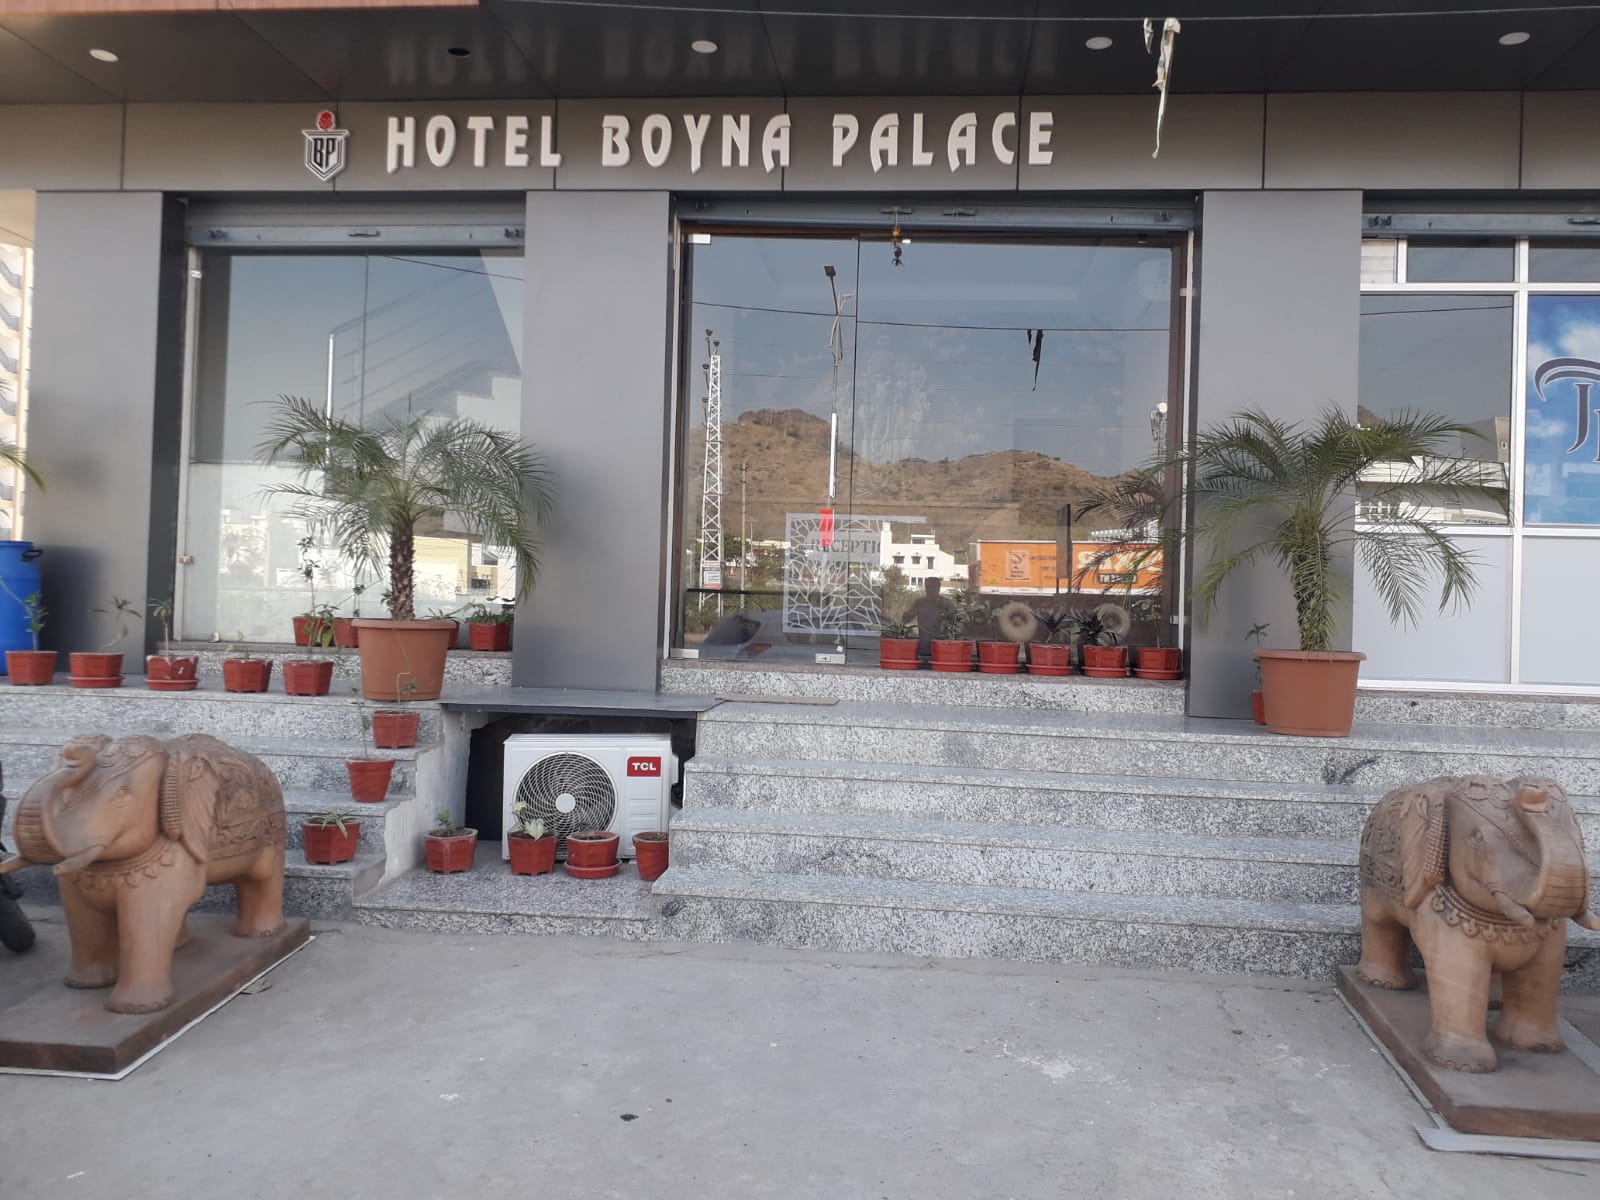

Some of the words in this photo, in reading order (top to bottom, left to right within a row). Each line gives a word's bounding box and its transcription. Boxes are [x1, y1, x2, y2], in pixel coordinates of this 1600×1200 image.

[313, 137, 337, 169] BP
[387, 114, 562, 174] HOTEL
[601, 113, 791, 174] BOYNA
[832, 112, 1054, 174] PALACE
[631, 762, 657, 771] TCL
